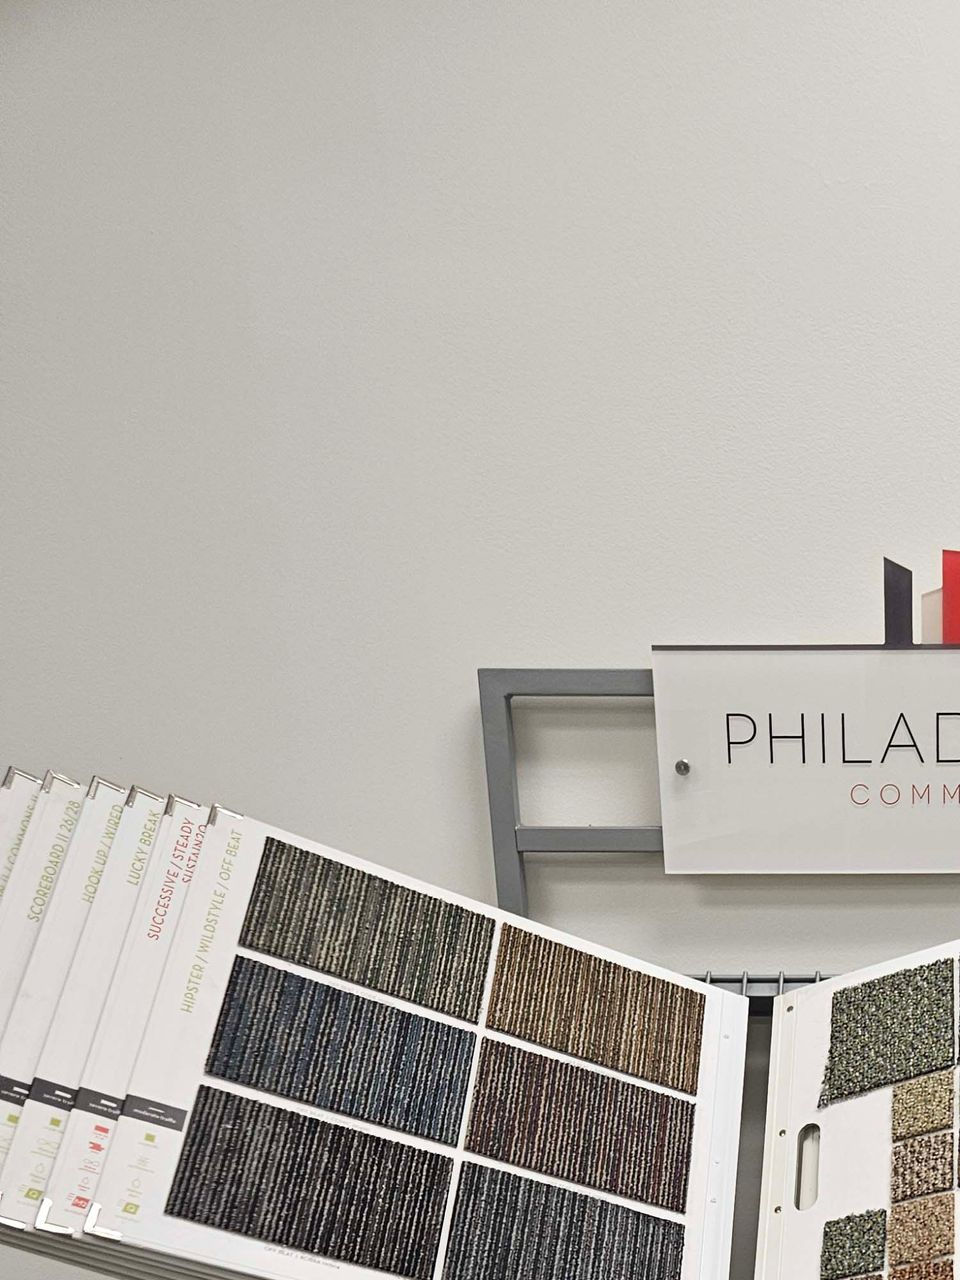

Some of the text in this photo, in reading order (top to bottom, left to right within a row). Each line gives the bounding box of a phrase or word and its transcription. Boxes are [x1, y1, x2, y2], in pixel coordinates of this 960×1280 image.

[101, 803, 124, 840] WIRED
[27, 844, 64, 924] SCOREBOARD
[58, 799, 82, 834] 26/28
[94, 850, 110, 867] UP
[126, 808, 161, 887] LUCKY BREAK
[224, 828, 243, 859] BEAT
[81, 866, 103, 904] HOOK
[147, 869, 179, 942] SUCCESSIVE
[172, 816, 195, 861] STEADY
[218, 860, 234, 881] OFF
[197, 891, 227, 955] WILDSTYLE
[180, 966, 206, 1014] HIPSTER
